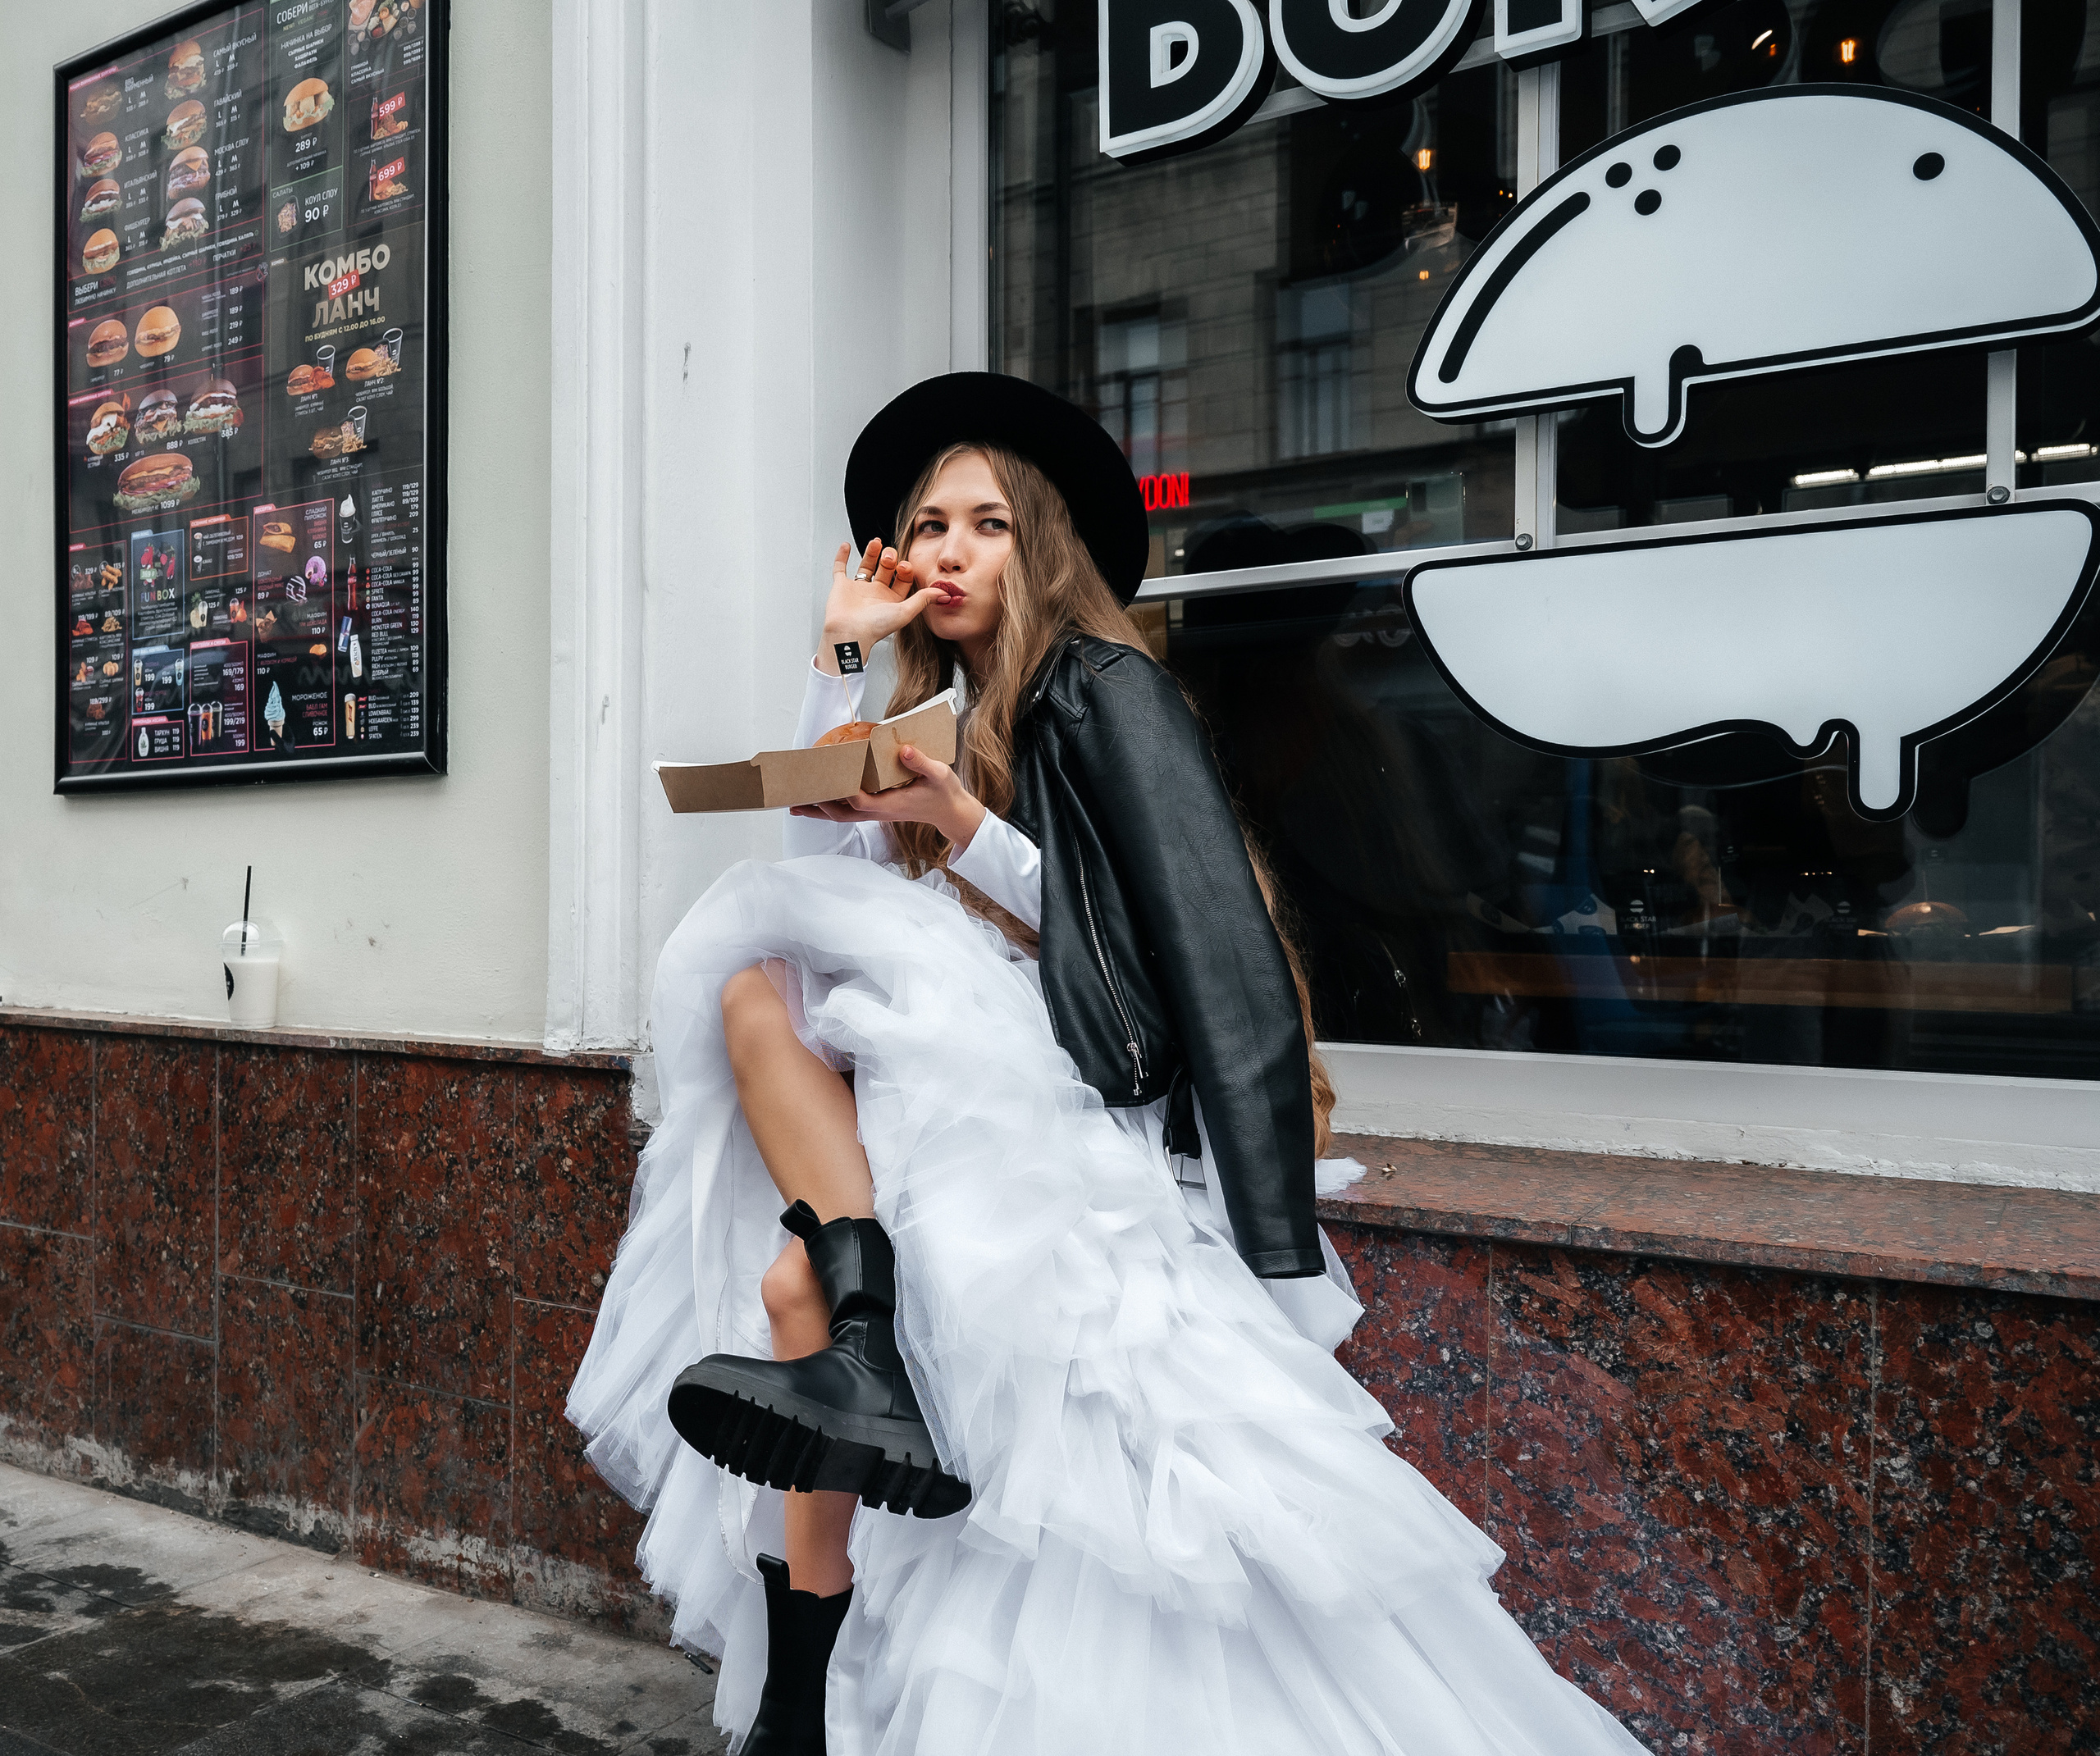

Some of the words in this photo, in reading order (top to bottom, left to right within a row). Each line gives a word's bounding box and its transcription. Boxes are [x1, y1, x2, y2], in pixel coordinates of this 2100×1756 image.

[276, 2, 308, 25] СОБЕРИ
[281, 33, 305, 50] НАЧИНКА
[314, 24, 332, 36] ВЫБОР
[212, 43, 232, 58] САМЫЙ
[232, 32, 257, 49] ВКУСНЫЙ
[288, 45, 305, 57] СЫРНЫЕ
[306, 39, 324, 50] ШАРИКИ
[350, 60, 369, 71] ГРИБНОЙ
[350, 66, 372, 77] КЛАССИКА
[351, 75, 365, 84] САМЫЙ
[366, 68, 385, 80] ВКУСНЫЙ
[379, 100, 395, 116] 599
[214, 144, 235, 156] МОСКВА
[235, 137, 249, 150] СЛОУ
[295, 139, 311, 153] 289
[300, 161, 309, 170] 109
[378, 165, 395, 181] 699
[215, 185, 237, 201] ГРИБНОЙ
[272, 186, 293, 198] САЛАТЫ
[305, 194, 321, 206] КОУЛ
[322, 188, 338, 202] СЛОУ
[305, 208, 320, 223] 90
[212, 249, 236, 262] ПЕРЧАТКИ
[304, 244, 390, 290] КОМБО
[75, 282, 99, 297] ВЫБЕРИ
[229, 286, 239, 295] 189
[331, 279, 349, 296] 329
[229, 307, 238, 315] 189
[312, 287, 380, 328] ЛАНЧ
[229, 322, 238, 330] 219
[314, 329, 338, 340] БУДНЯМ
[344, 322, 358, 332] 12.00
[359, 320, 369, 329] ДО
[369, 316, 386, 326] 16.00
[227, 336, 238, 345] 249
[163, 354, 171, 363] 79
[113, 368, 121, 376] 77
[364, 379, 376, 388] ЛАНЧ
[300, 395, 312, 403] ЛАНЧ
[221, 427, 234, 438] 385
[166, 440, 179, 450] 888
[114, 453, 125, 463] 335
[330, 458, 341, 466] ЛАНЧ
[372, 487, 393, 495] КАПУЧИНО
[160, 499, 175, 509] 1099
[372, 501, 395, 510] АМЕРИКАНО
[402, 496, 419, 504] 89/109
[305, 506, 326, 515] СЛАДКИЙ
[304, 513, 327, 522] ПИРОЖОК
[258, 569, 272, 577] ДОНАТ
[371, 566, 392, 574] COCA-COLA
[371, 572, 392, 581] COCA-COLA
[371, 580, 392, 588] COCA-COLA
[141, 591, 156, 603] FUN
[157, 587, 175, 600] BOX
[307, 611, 327, 619] МАФФИН
[222, 668, 244, 676] 169/179
[372, 668, 389, 677] ДОБРЫЙ
[144, 673, 155, 682] 199
[162, 676, 172, 684] 199
[292, 691, 328, 701] МОРОЖЕНОЕ
[144, 702, 155, 710] 199
[313, 727, 323, 737] 65
[235, 739, 245, 747] 199
